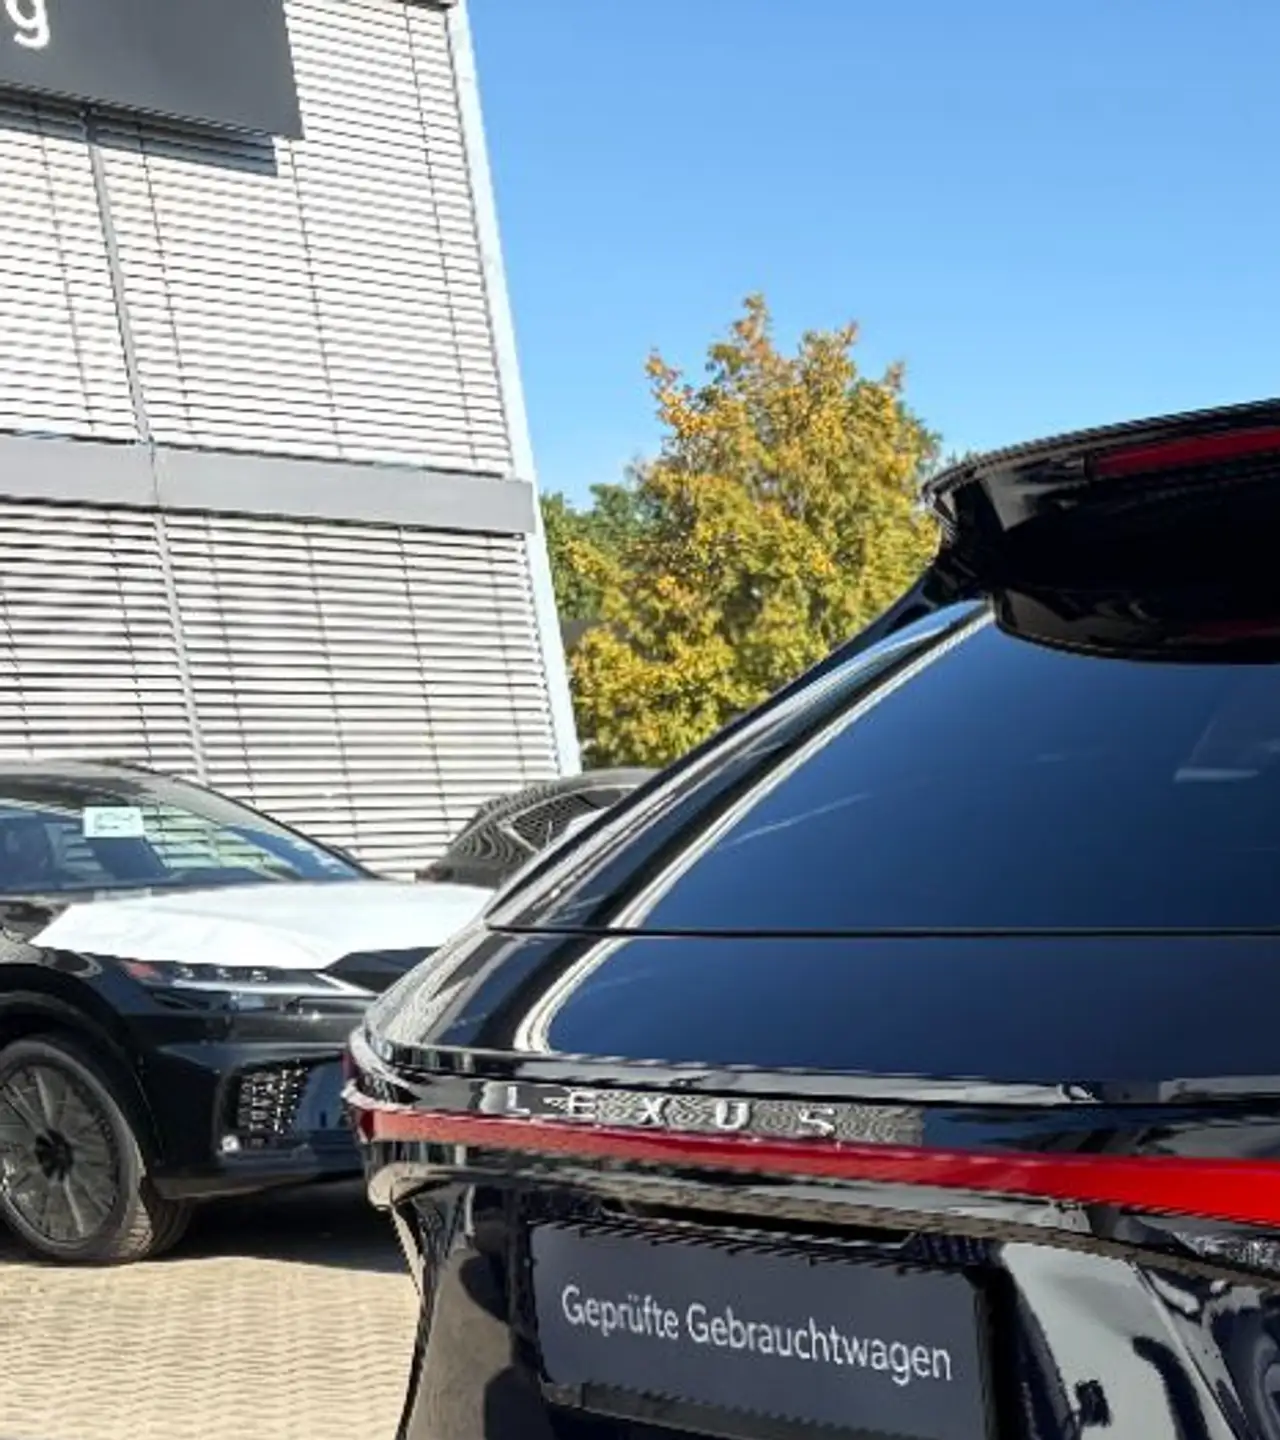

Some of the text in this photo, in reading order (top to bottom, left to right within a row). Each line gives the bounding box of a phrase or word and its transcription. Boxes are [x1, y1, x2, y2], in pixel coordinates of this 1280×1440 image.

[506, 1085, 836, 1137] LEXUS
[561, 1284, 953, 1386] Geprüfte Gebrauchtwagen
